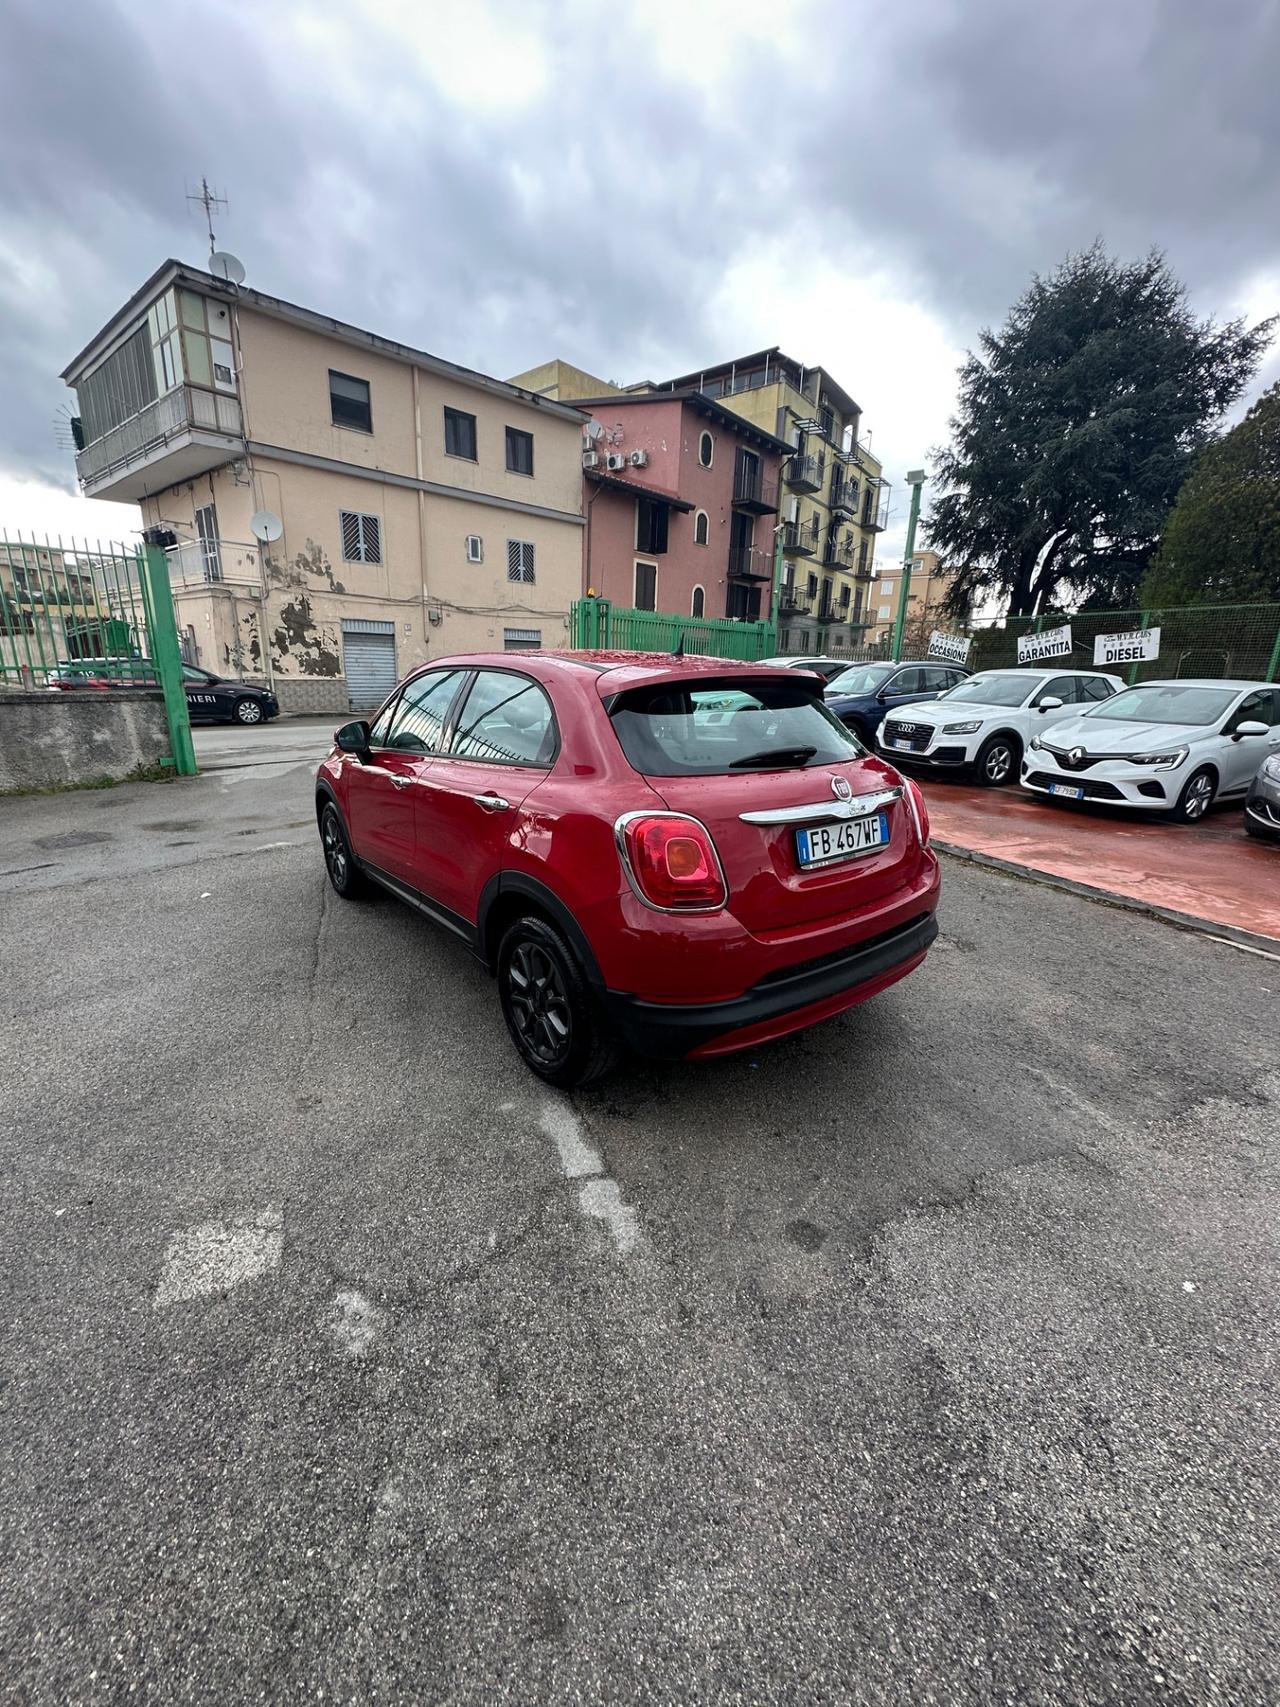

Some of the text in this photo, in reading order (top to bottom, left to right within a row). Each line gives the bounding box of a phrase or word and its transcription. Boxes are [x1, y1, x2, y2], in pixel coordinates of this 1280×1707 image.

[930, 643, 966, 661] OCCASIONE
[1019, 640, 1070, 662] GARANTITA
[1106, 646, 1146, 662] DIESEL
[810, 818, 878, 858] FB 467WF
